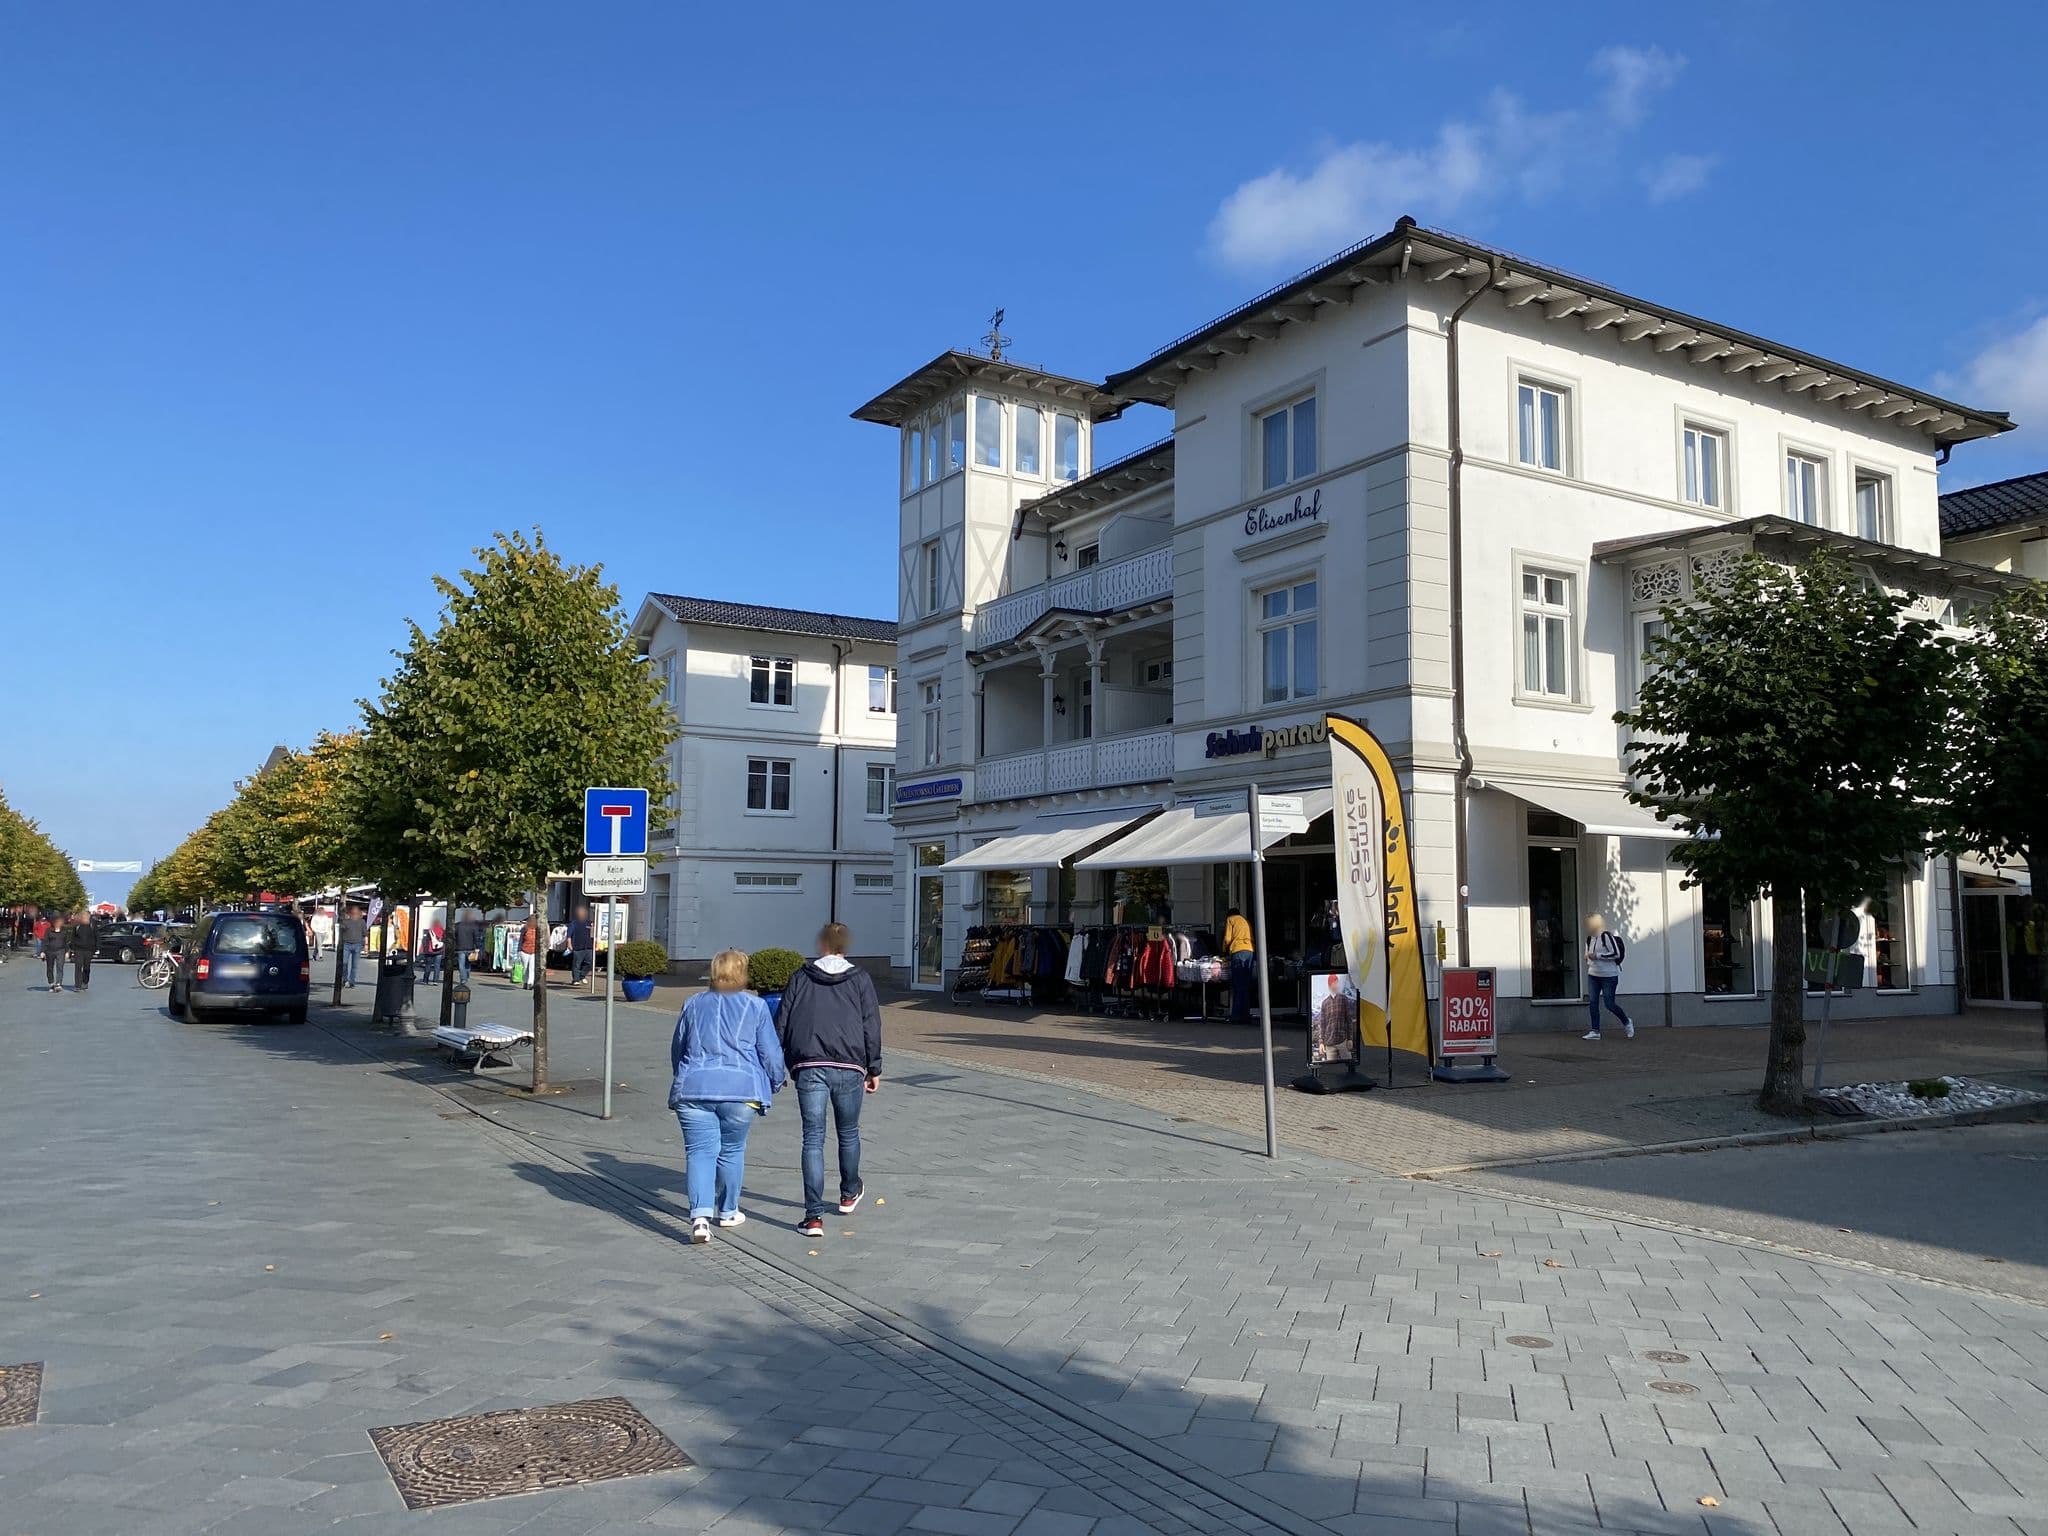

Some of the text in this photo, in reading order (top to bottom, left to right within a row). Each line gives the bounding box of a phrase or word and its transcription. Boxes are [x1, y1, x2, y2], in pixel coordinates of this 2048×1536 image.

[1245, 489, 1322, 536] Elisenhof
[607, 865, 624, 874] Keine
[588, 877, 642, 888] Wendemöglichkeit
[1449, 996, 1489, 1018] 30%
[1449, 1019, 1489, 1033] RABATT
